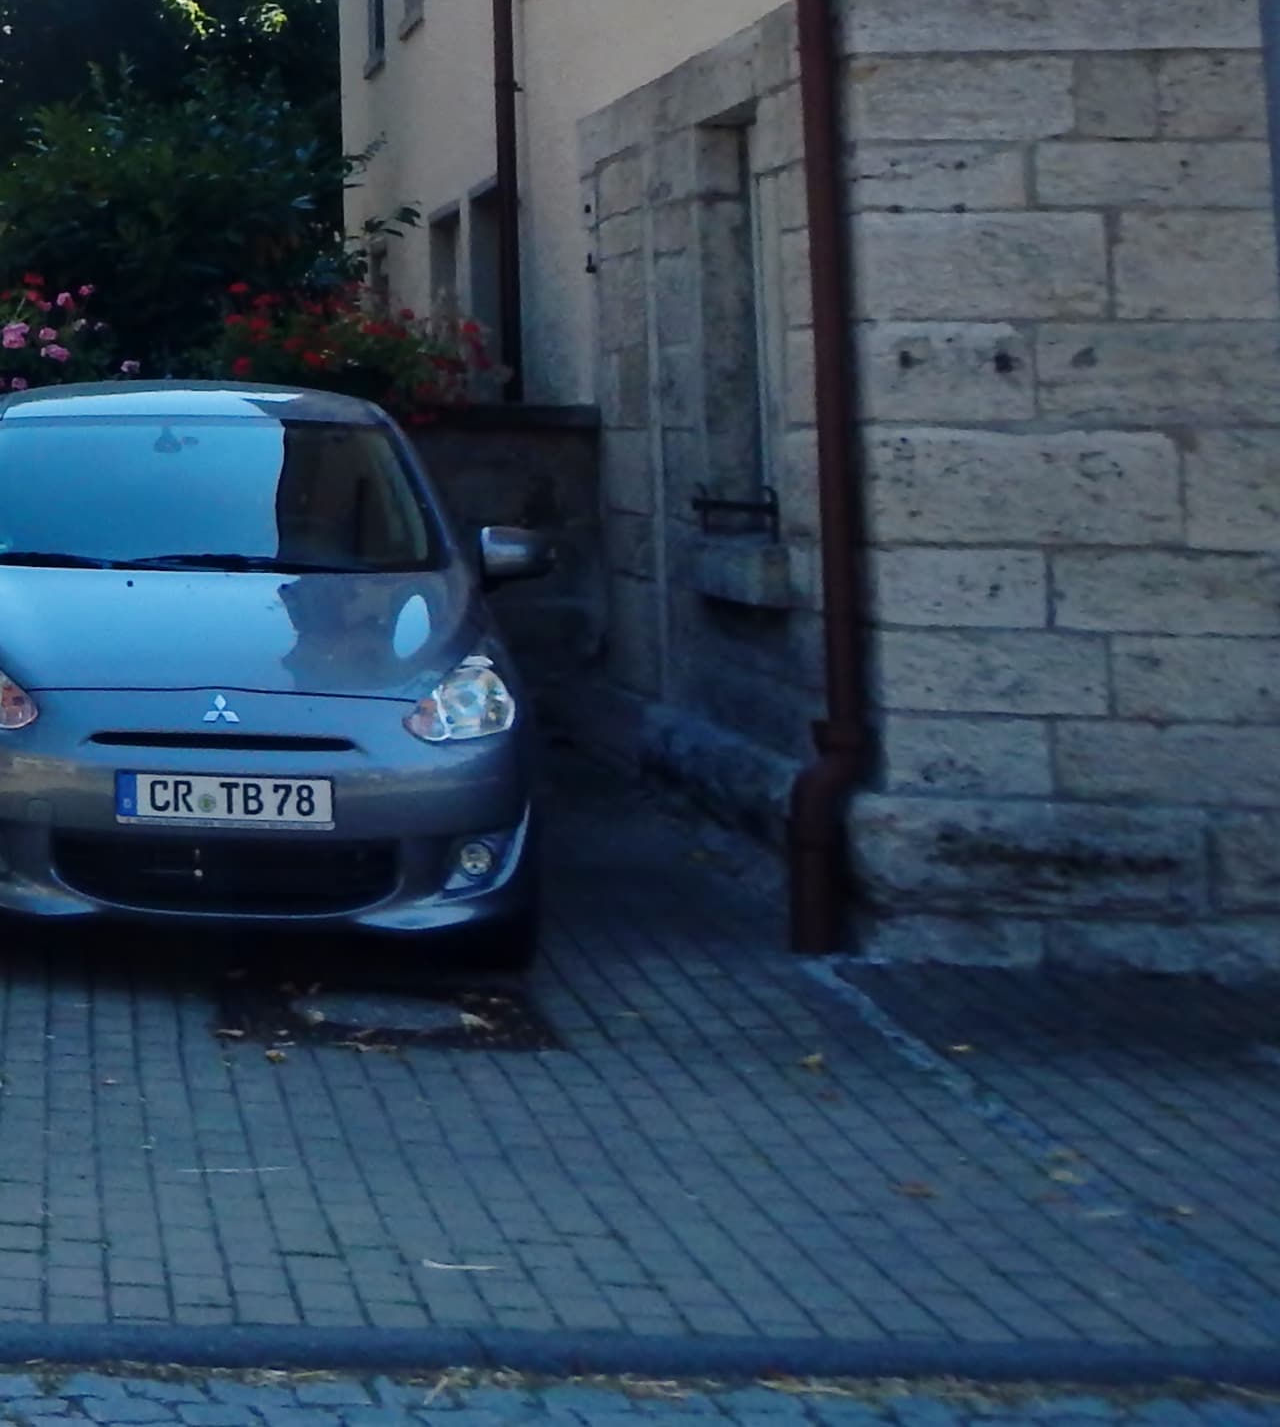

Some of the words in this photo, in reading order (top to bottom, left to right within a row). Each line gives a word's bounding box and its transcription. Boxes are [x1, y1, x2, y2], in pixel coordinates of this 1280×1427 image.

[149, 779, 194, 813] CR
[219, 782, 264, 815] TB
[272, 783, 315, 817] 78
